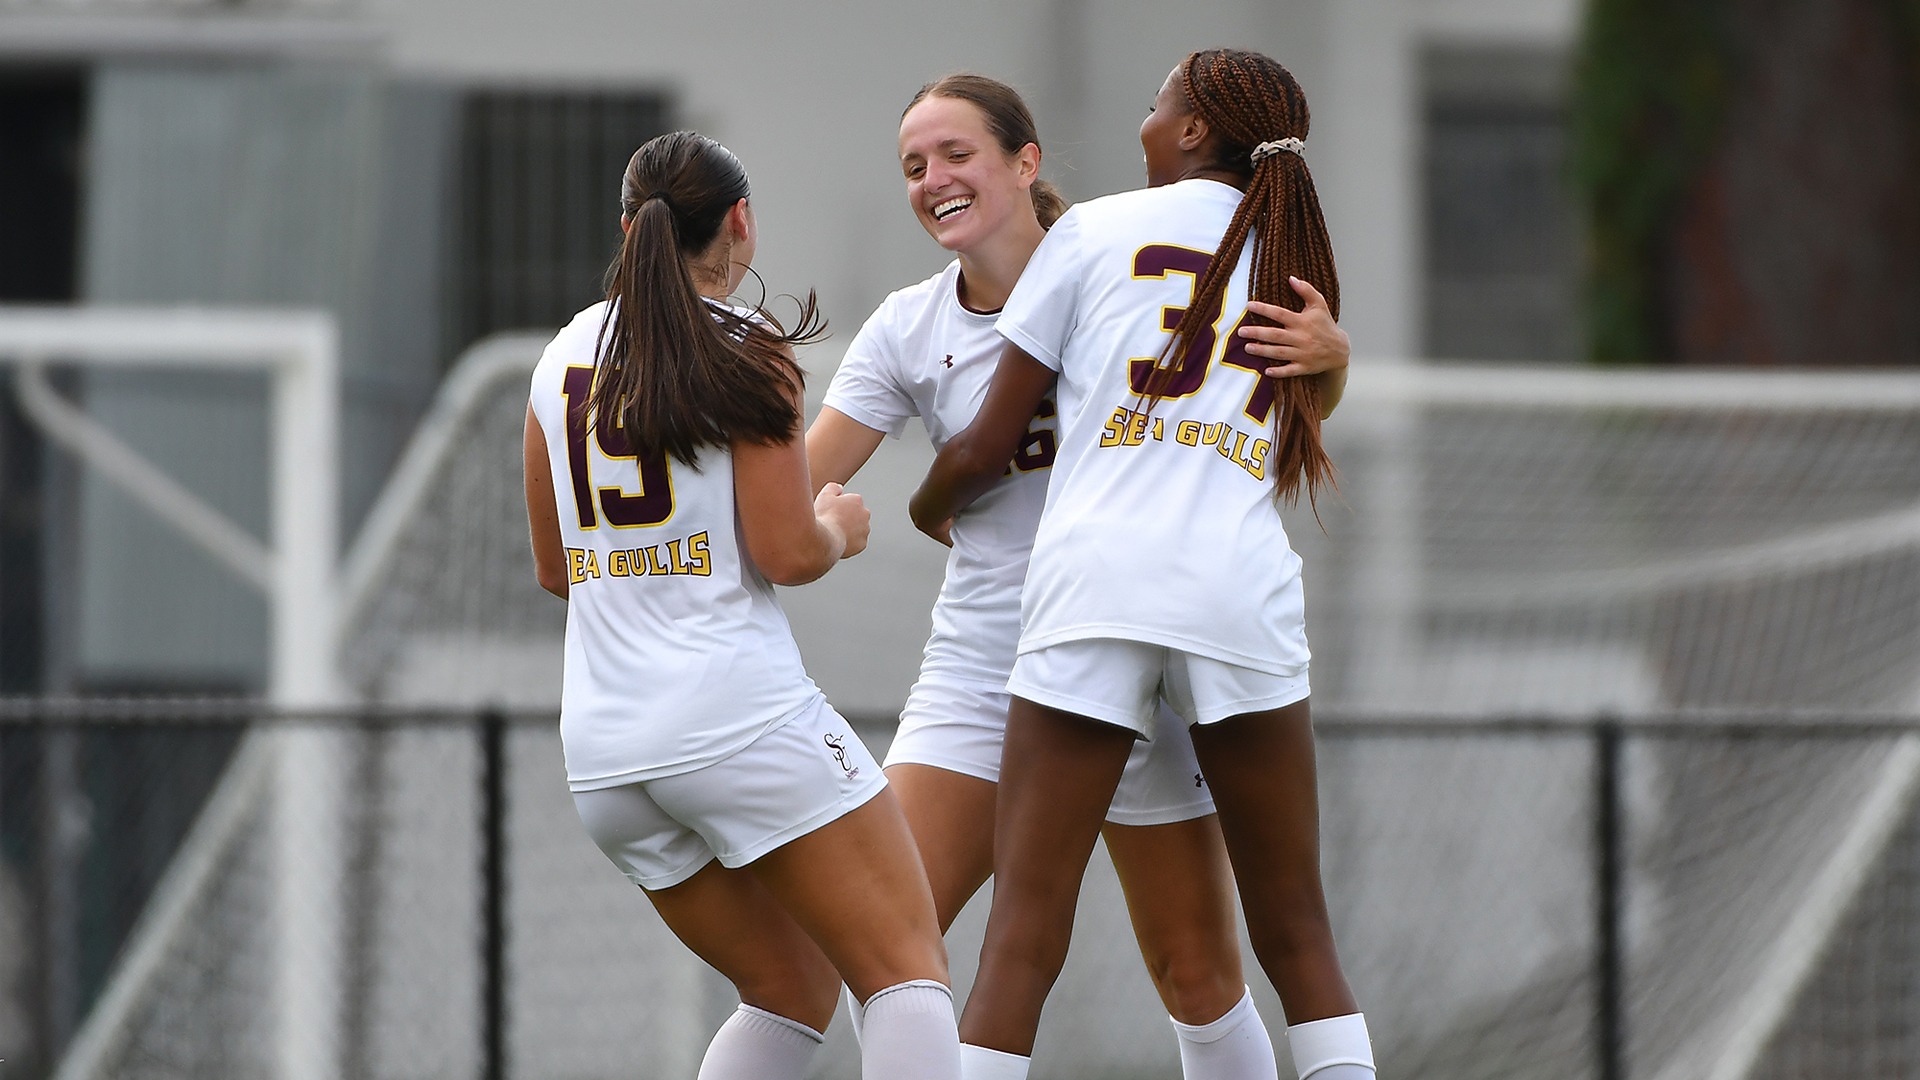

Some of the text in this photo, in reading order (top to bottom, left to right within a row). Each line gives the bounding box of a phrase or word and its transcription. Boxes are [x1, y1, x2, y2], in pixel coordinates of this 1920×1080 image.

[1176, 420, 1271, 481] GULLS
[566, 531, 712, 585] EA GULLS
